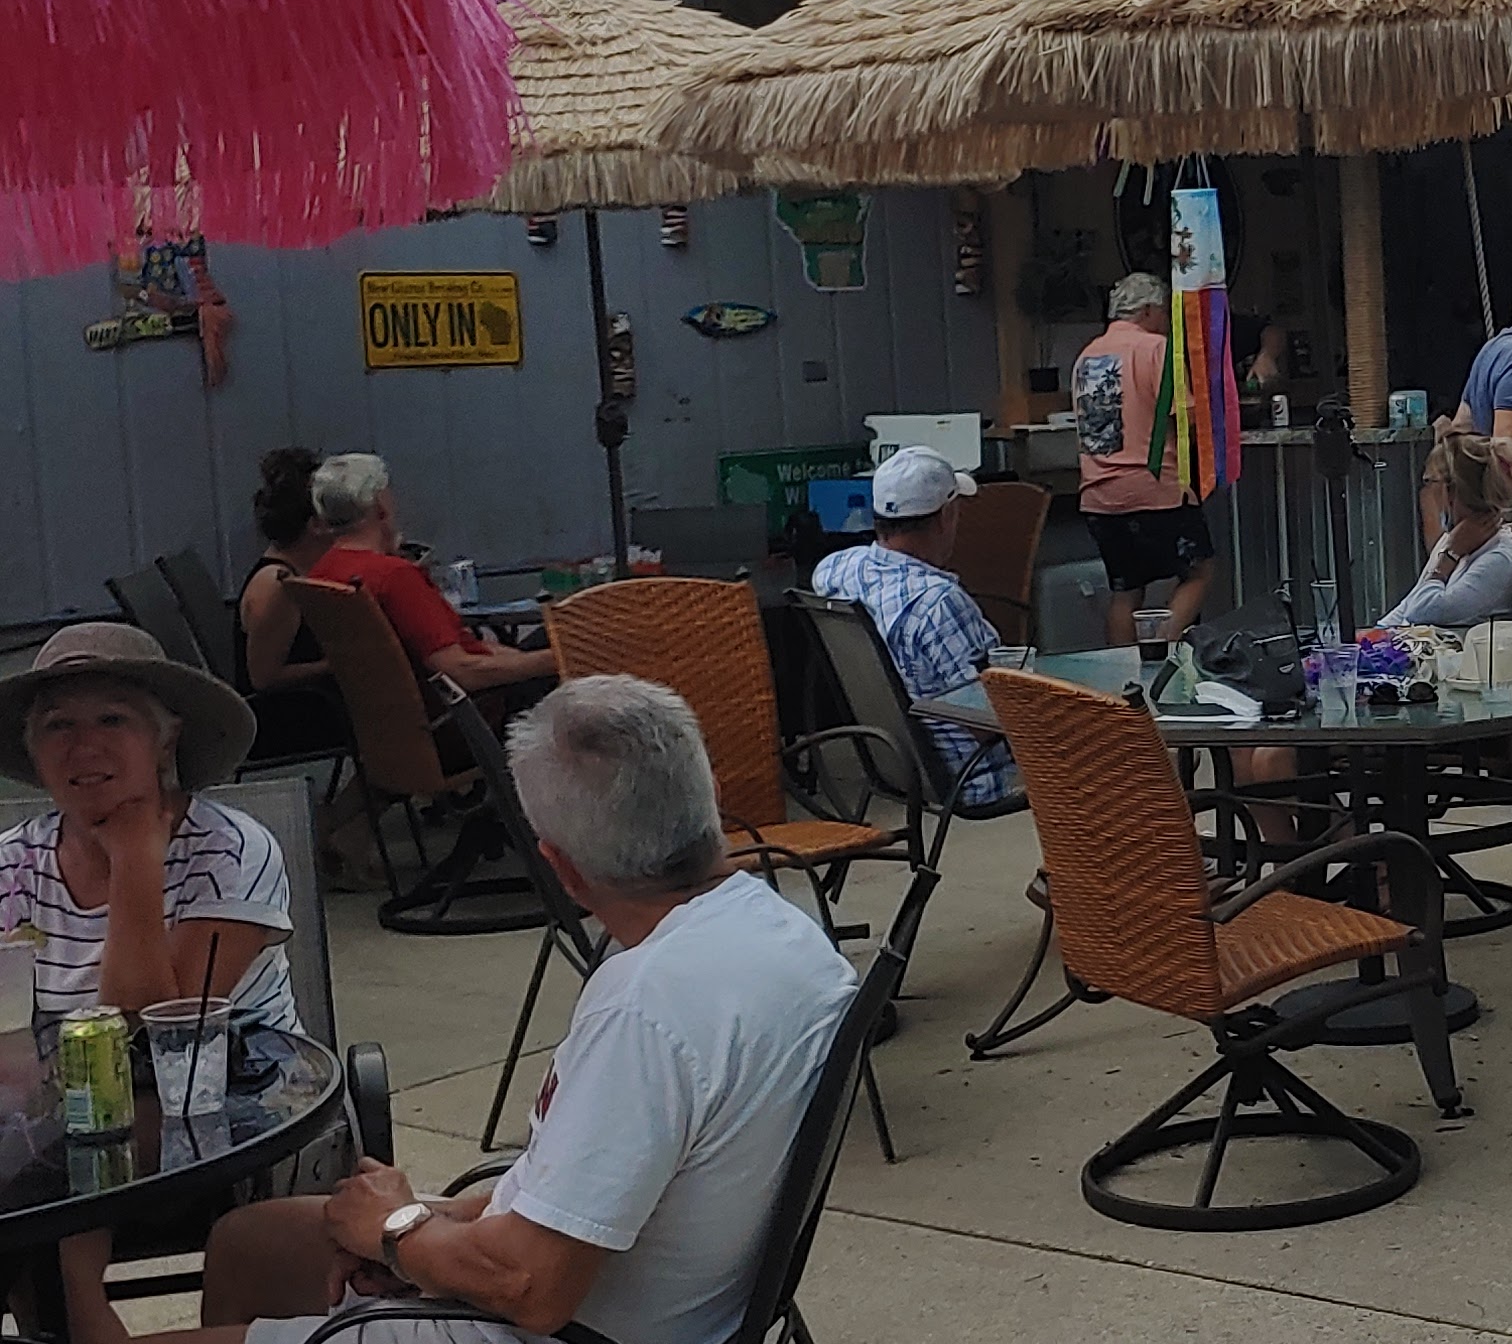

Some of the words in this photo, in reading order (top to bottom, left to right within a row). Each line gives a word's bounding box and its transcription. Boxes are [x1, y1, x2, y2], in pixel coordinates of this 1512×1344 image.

[369, 302, 441, 348] ONLY
[448, 302, 476, 346] IN
[777, 463, 849, 482] Welcome
